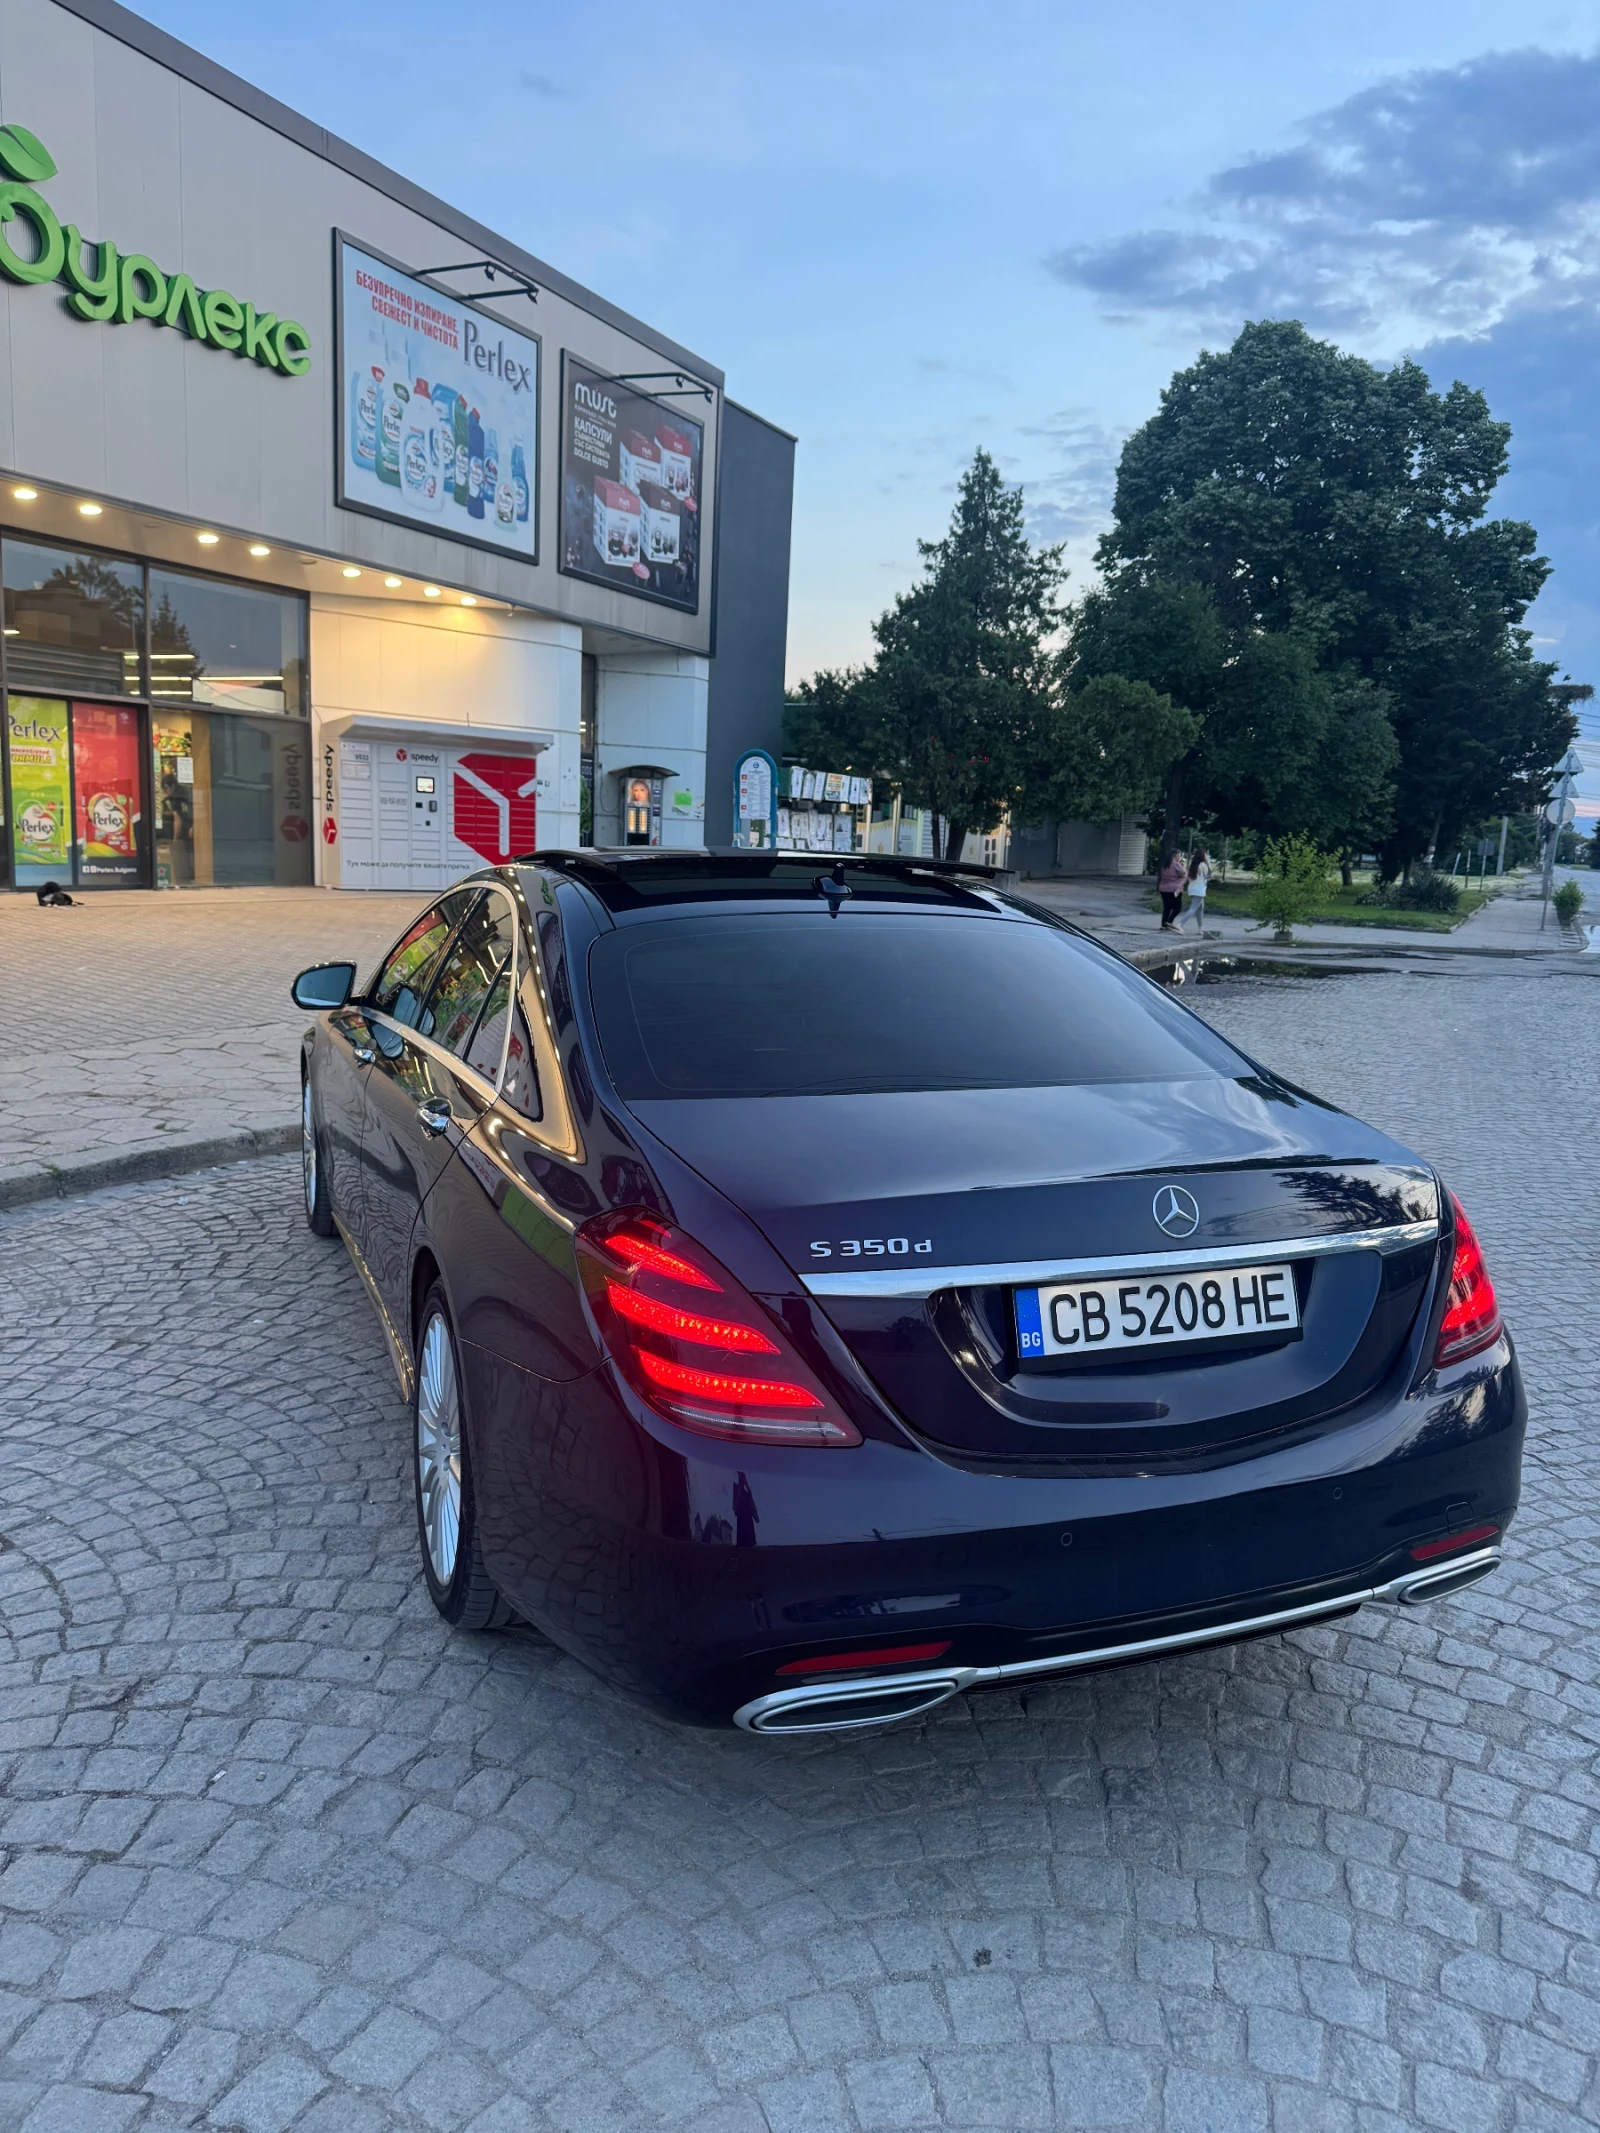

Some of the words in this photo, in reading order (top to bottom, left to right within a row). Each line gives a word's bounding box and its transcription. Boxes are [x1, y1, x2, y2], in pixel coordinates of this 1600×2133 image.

[356, 269, 413, 311] БЕЗУПРЕЧНО
[372, 295, 412, 327] СВЕЖЕСТ
[414, 316, 420, 331] И
[421, 320, 458, 350] ЧИСТОТА
[464, 319, 530, 391] Perlex
[575, 382, 617, 418] must
[574, 416, 612, 445] КАПСУЛИ
[574, 447, 591, 462] DOLCE
[592, 455, 609, 469] GUSTO
[12, 753, 52, 764] ORMULA
[411, 752, 439, 763] speedy
[324, 744, 335, 811] speedy
[22, 819, 55, 835] Perlex
[93, 812, 125, 827] Perlex
[346, 860, 359, 868] Тук
[389, 861, 421, 869] получите
[1049, 1290, 1110, 1345] CB
[1118, 1280, 1226, 1338] 5208
[1232, 1272, 1290, 1326] HE
[1020, 1331, 1041, 1349] BG
